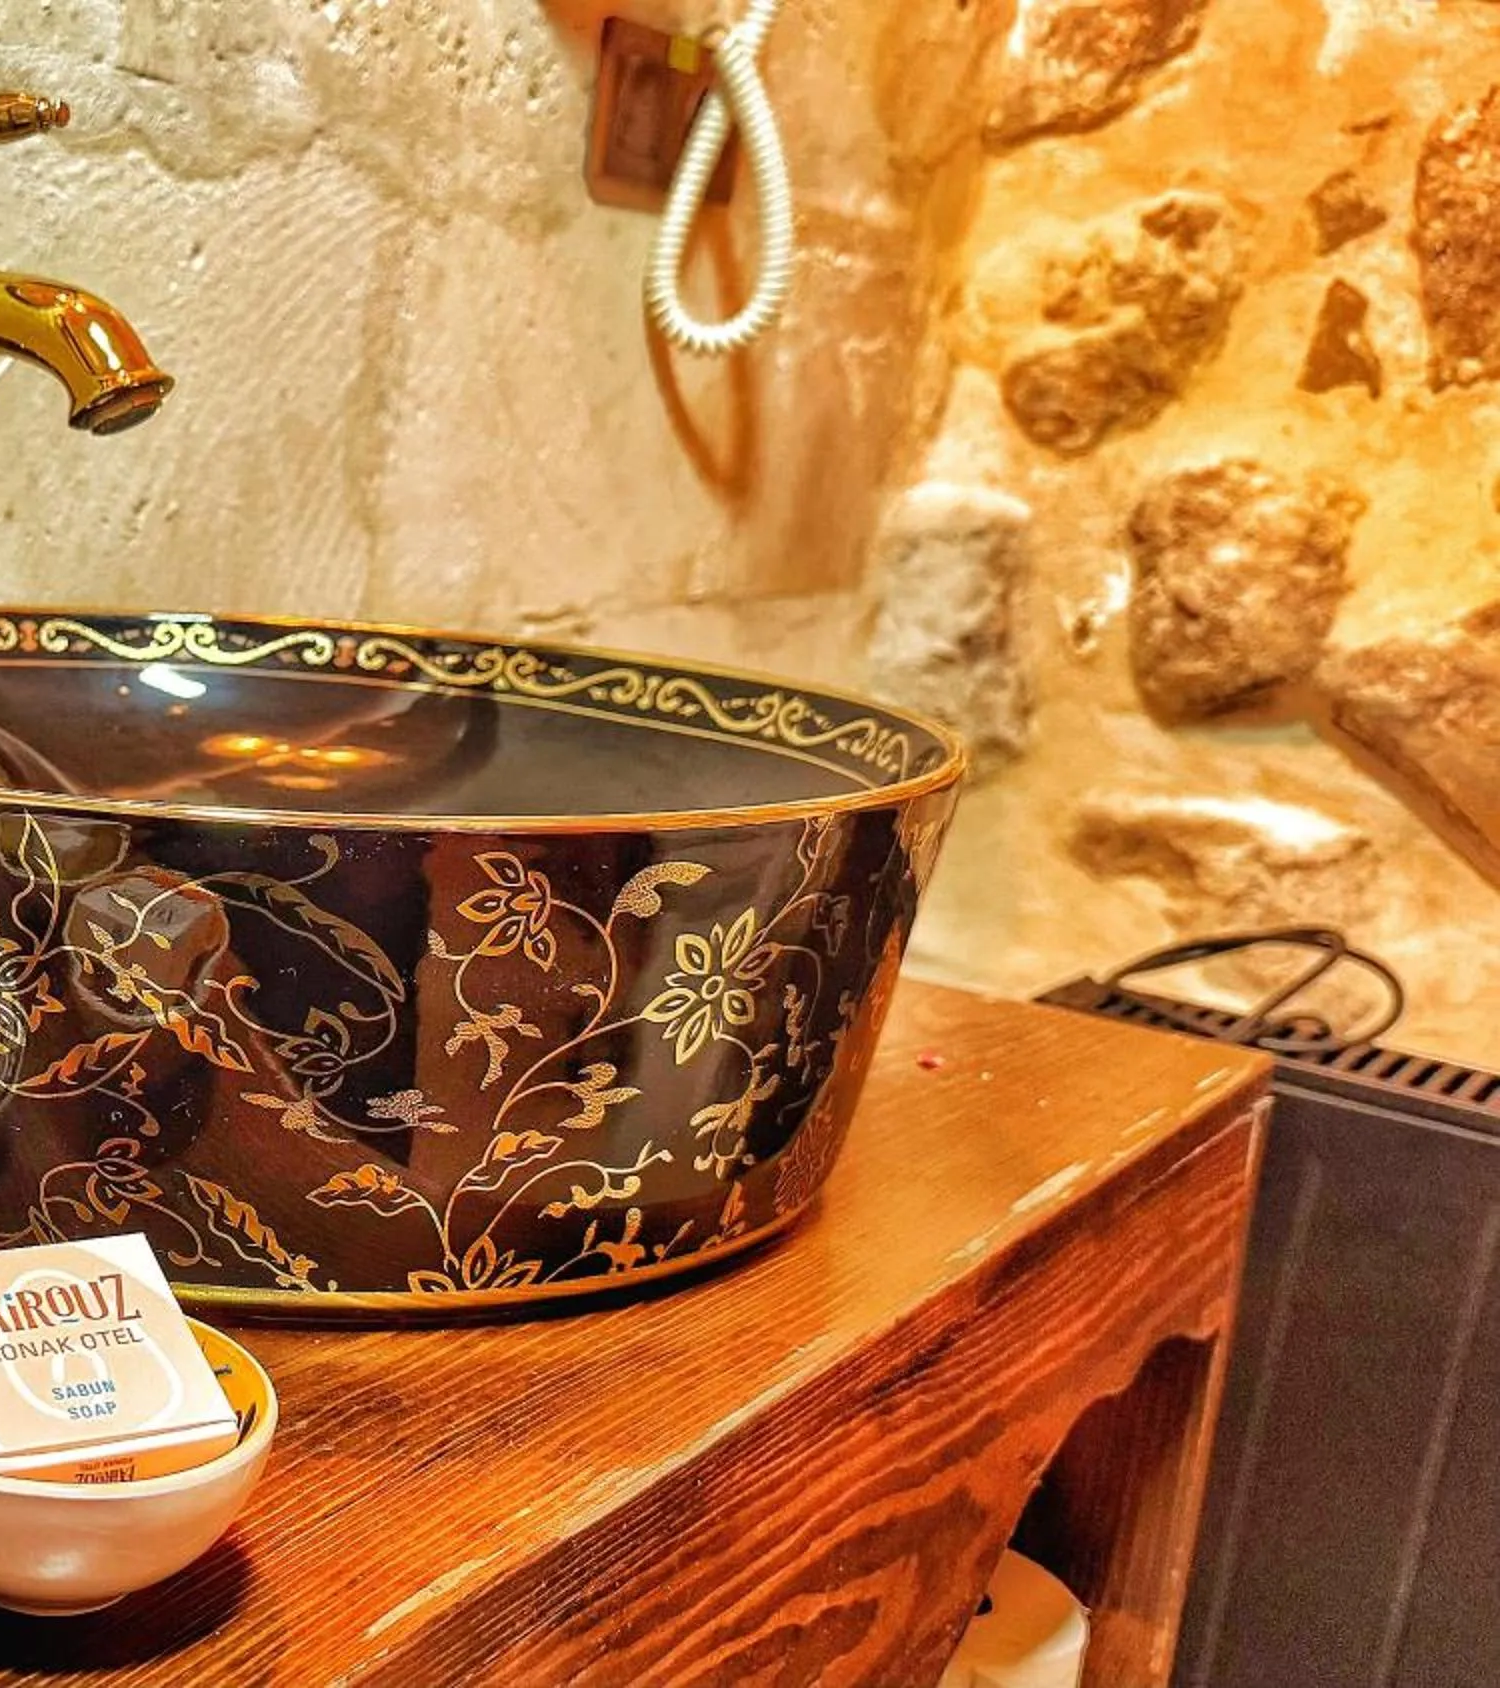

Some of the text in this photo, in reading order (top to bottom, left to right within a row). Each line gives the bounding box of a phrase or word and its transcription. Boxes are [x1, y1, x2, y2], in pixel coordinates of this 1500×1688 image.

[80, 1327, 144, 1351] OTEL
[52, 1379, 116, 1402] SABUN
[67, 1401, 117, 1421] SOAP
